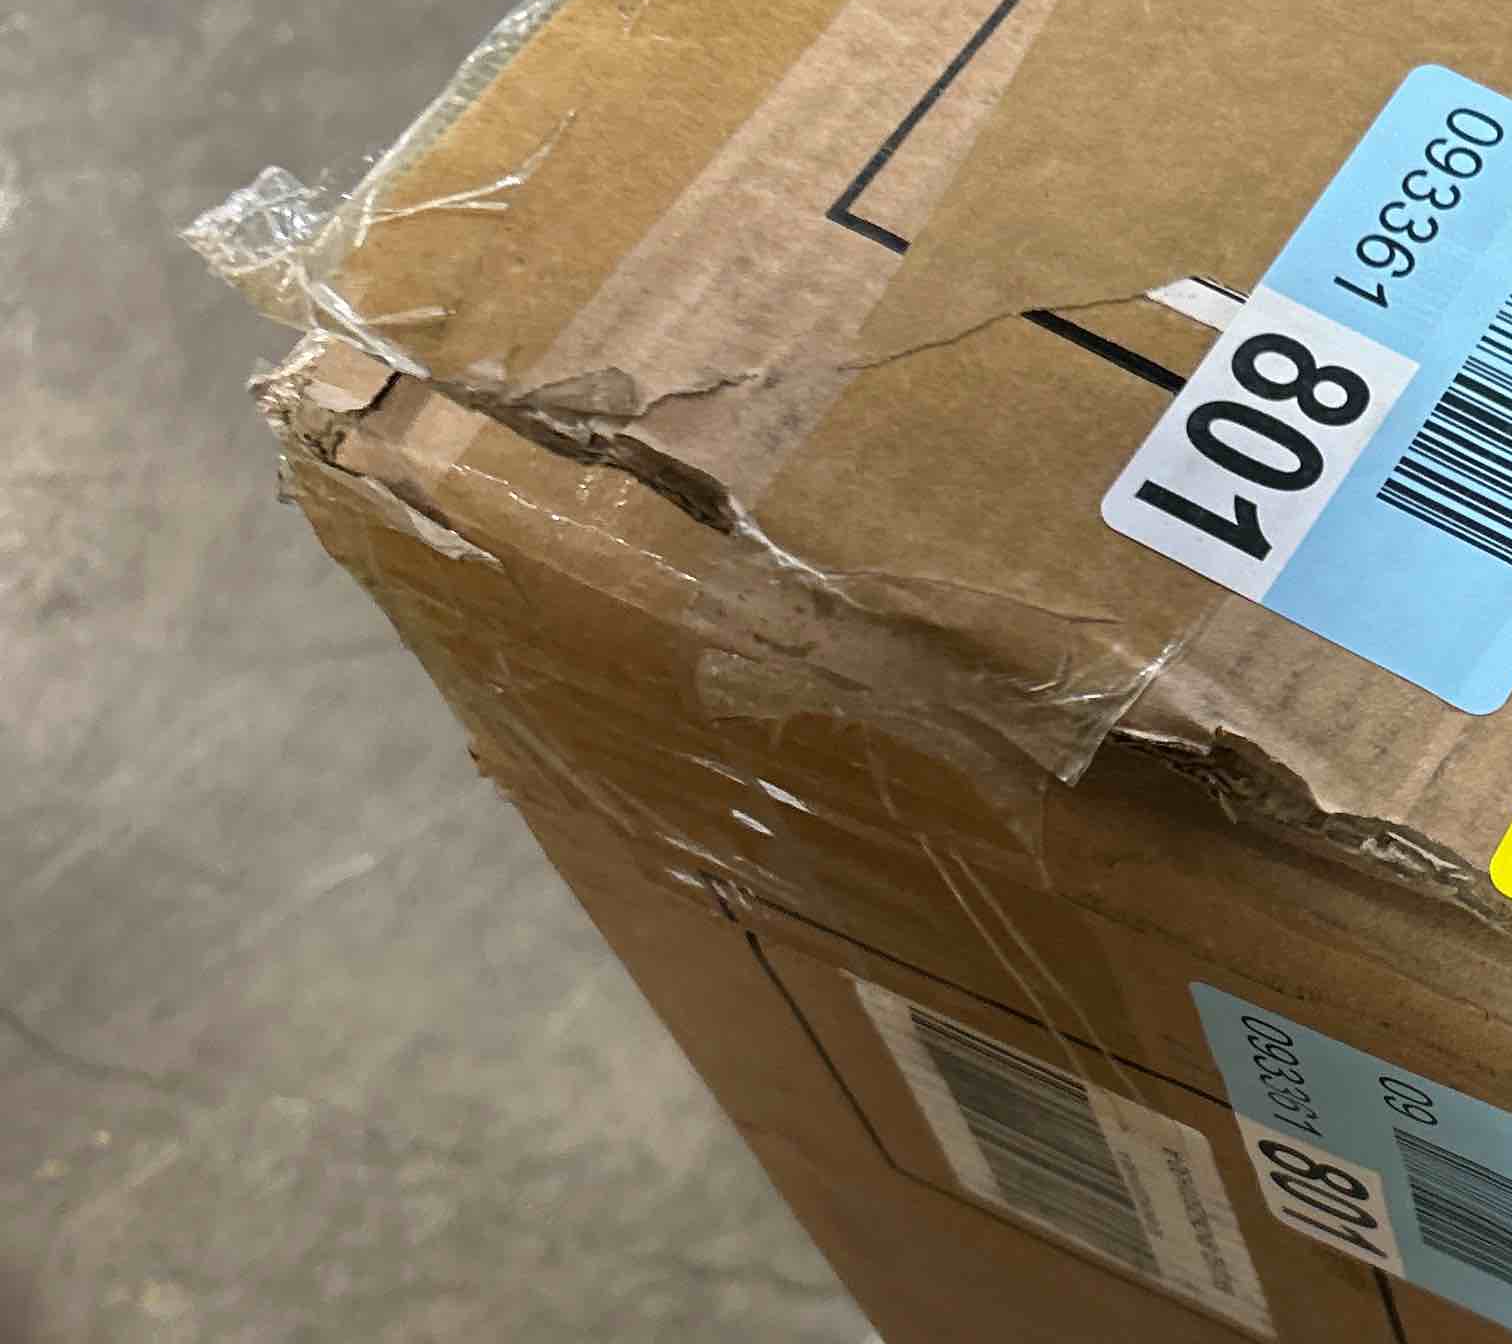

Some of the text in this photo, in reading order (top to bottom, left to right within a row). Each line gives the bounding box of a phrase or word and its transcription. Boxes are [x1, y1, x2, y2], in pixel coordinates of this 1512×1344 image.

[1333, 107, 1505, 309] 093361
[1135, 332, 1371, 561] 801
[1241, 1016, 1323, 1137] 093361
[1378, 1076, 1438, 1126] 09
[1258, 1139, 1388, 1259] 801
